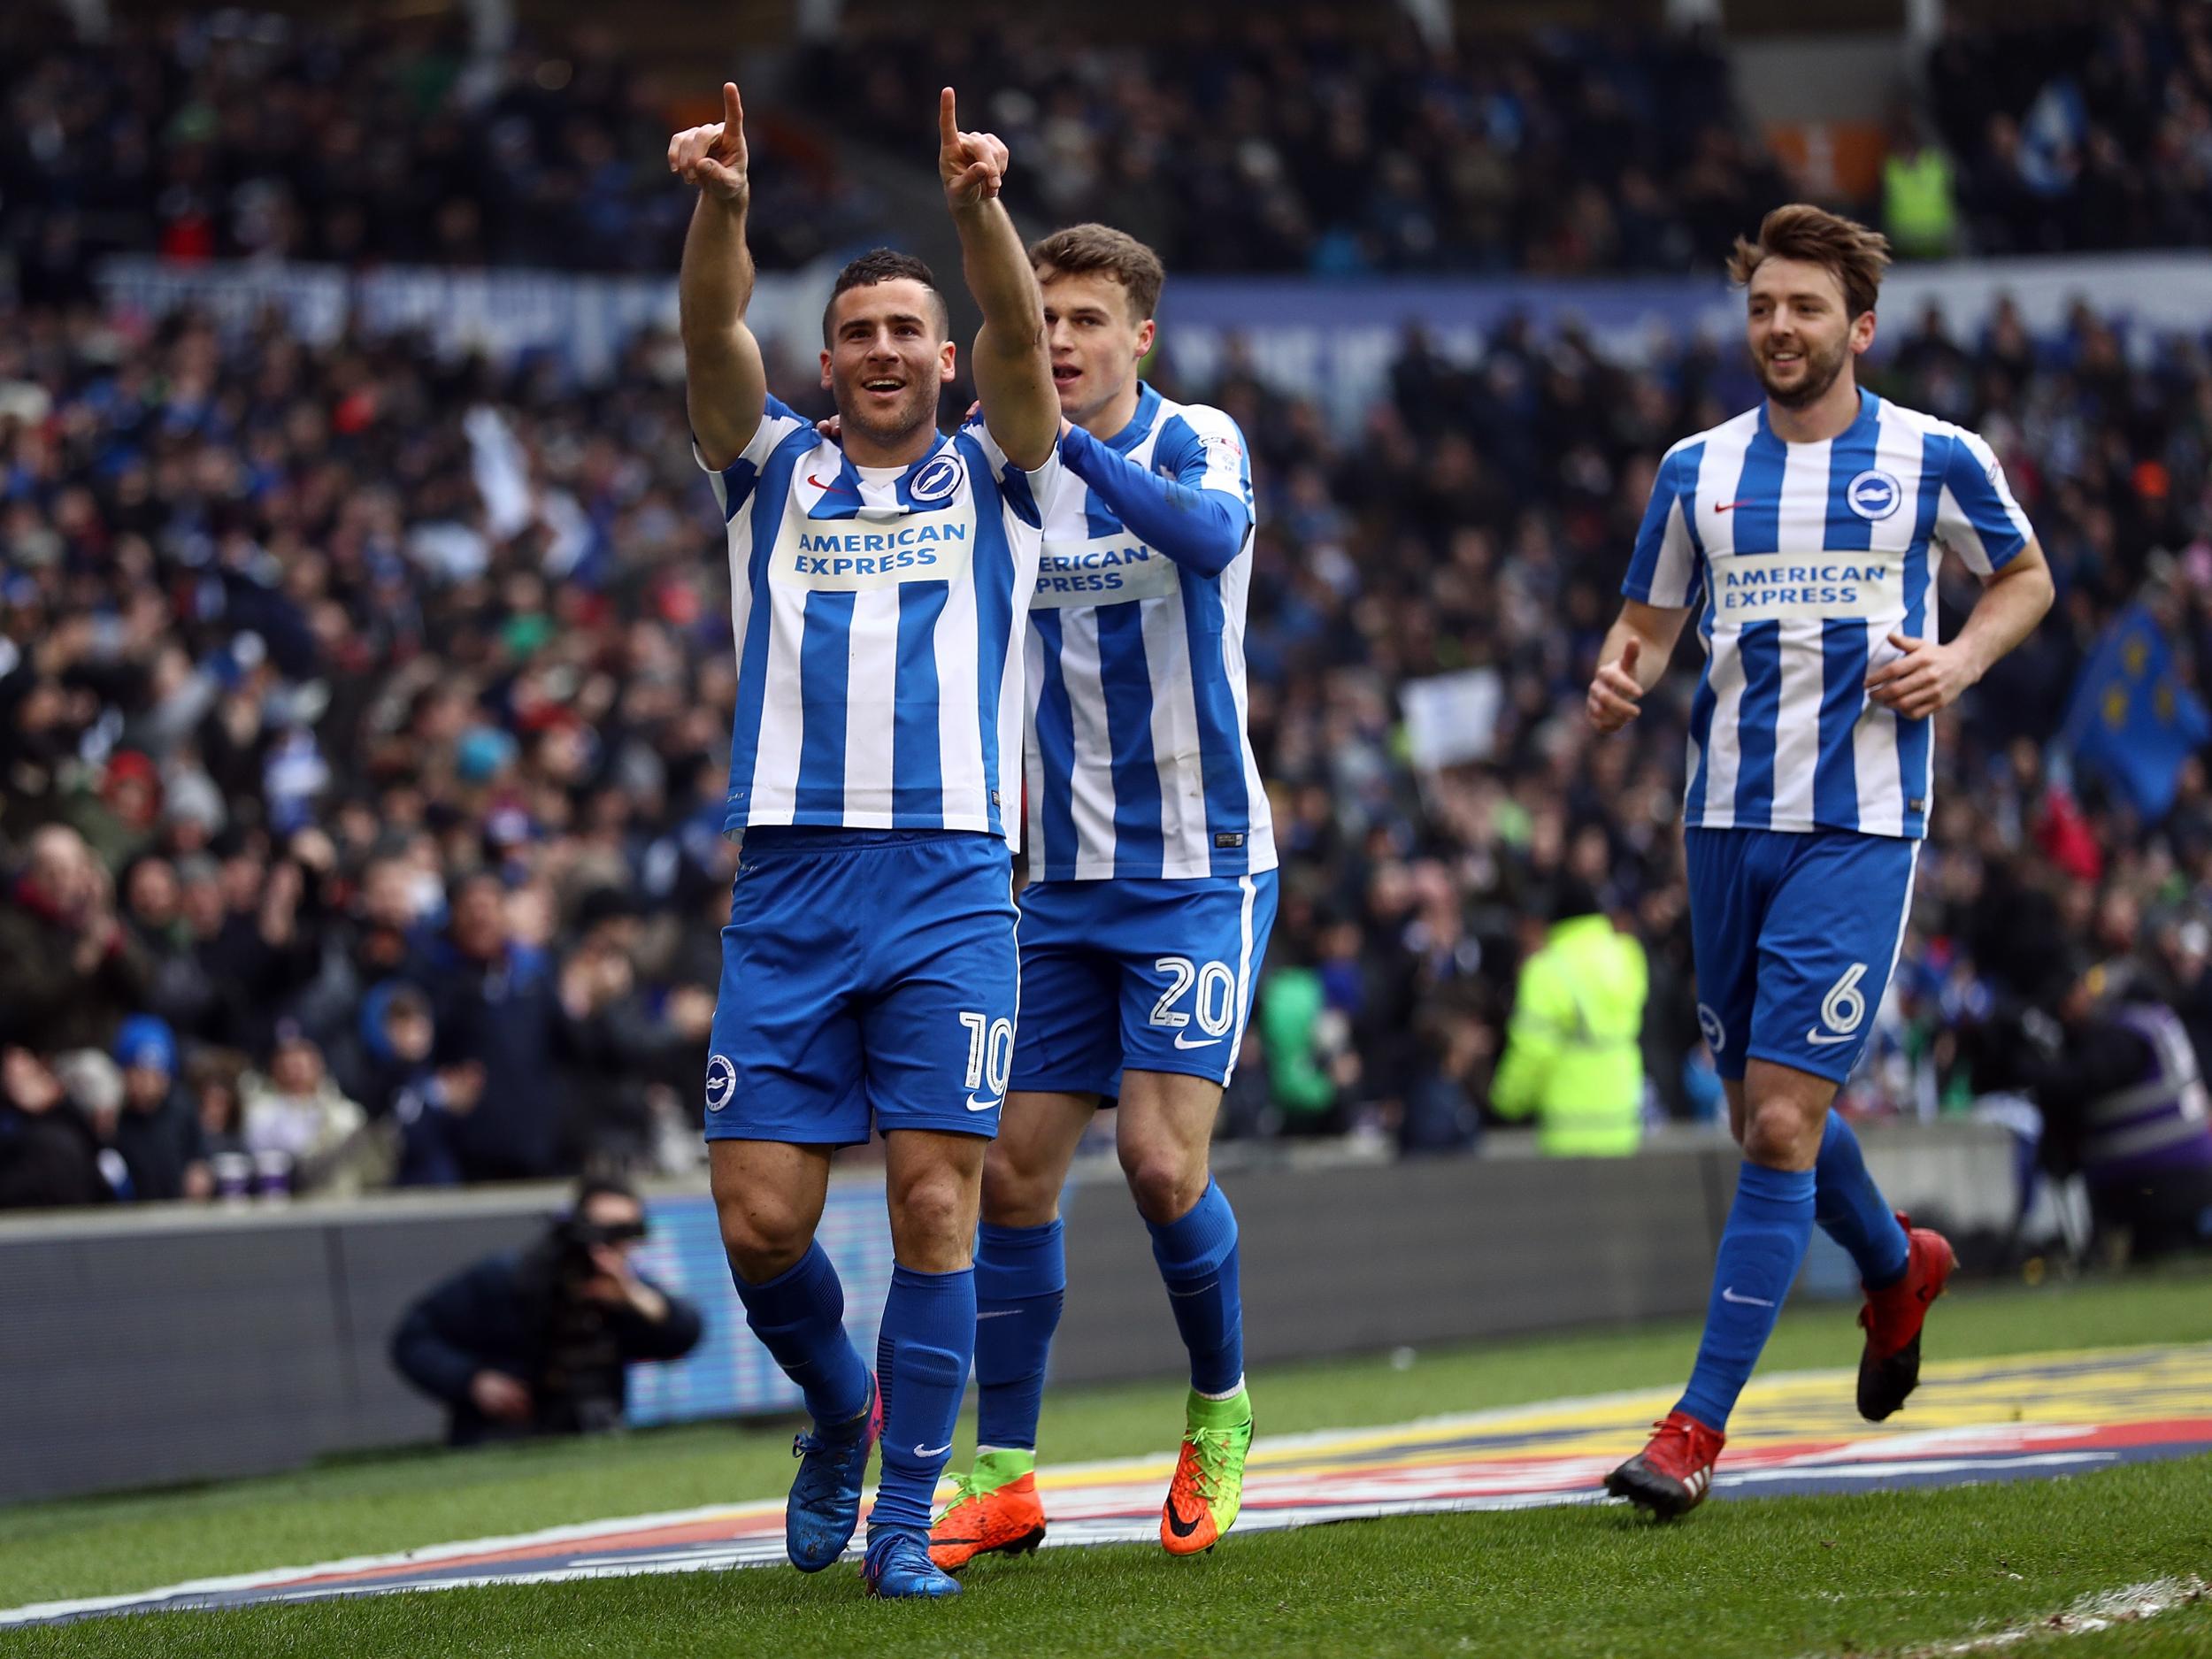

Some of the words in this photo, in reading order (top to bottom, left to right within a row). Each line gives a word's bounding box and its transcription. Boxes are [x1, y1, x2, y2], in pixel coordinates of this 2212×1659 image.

[799, 524, 965, 552] AMERICAN
[795, 548, 938, 575] EXPRESS
[1039, 545, 1149, 572] ERICAN
[1035, 572, 1124, 594] PRESS
[1727, 565, 1886, 587] AMERICAN
[1725, 587, 1857, 608] EXPRESS
[1149, 956, 1235, 1037] 20
[1821, 962, 1869, 1034] 6
[959, 1011, 1013, 1095] 10
